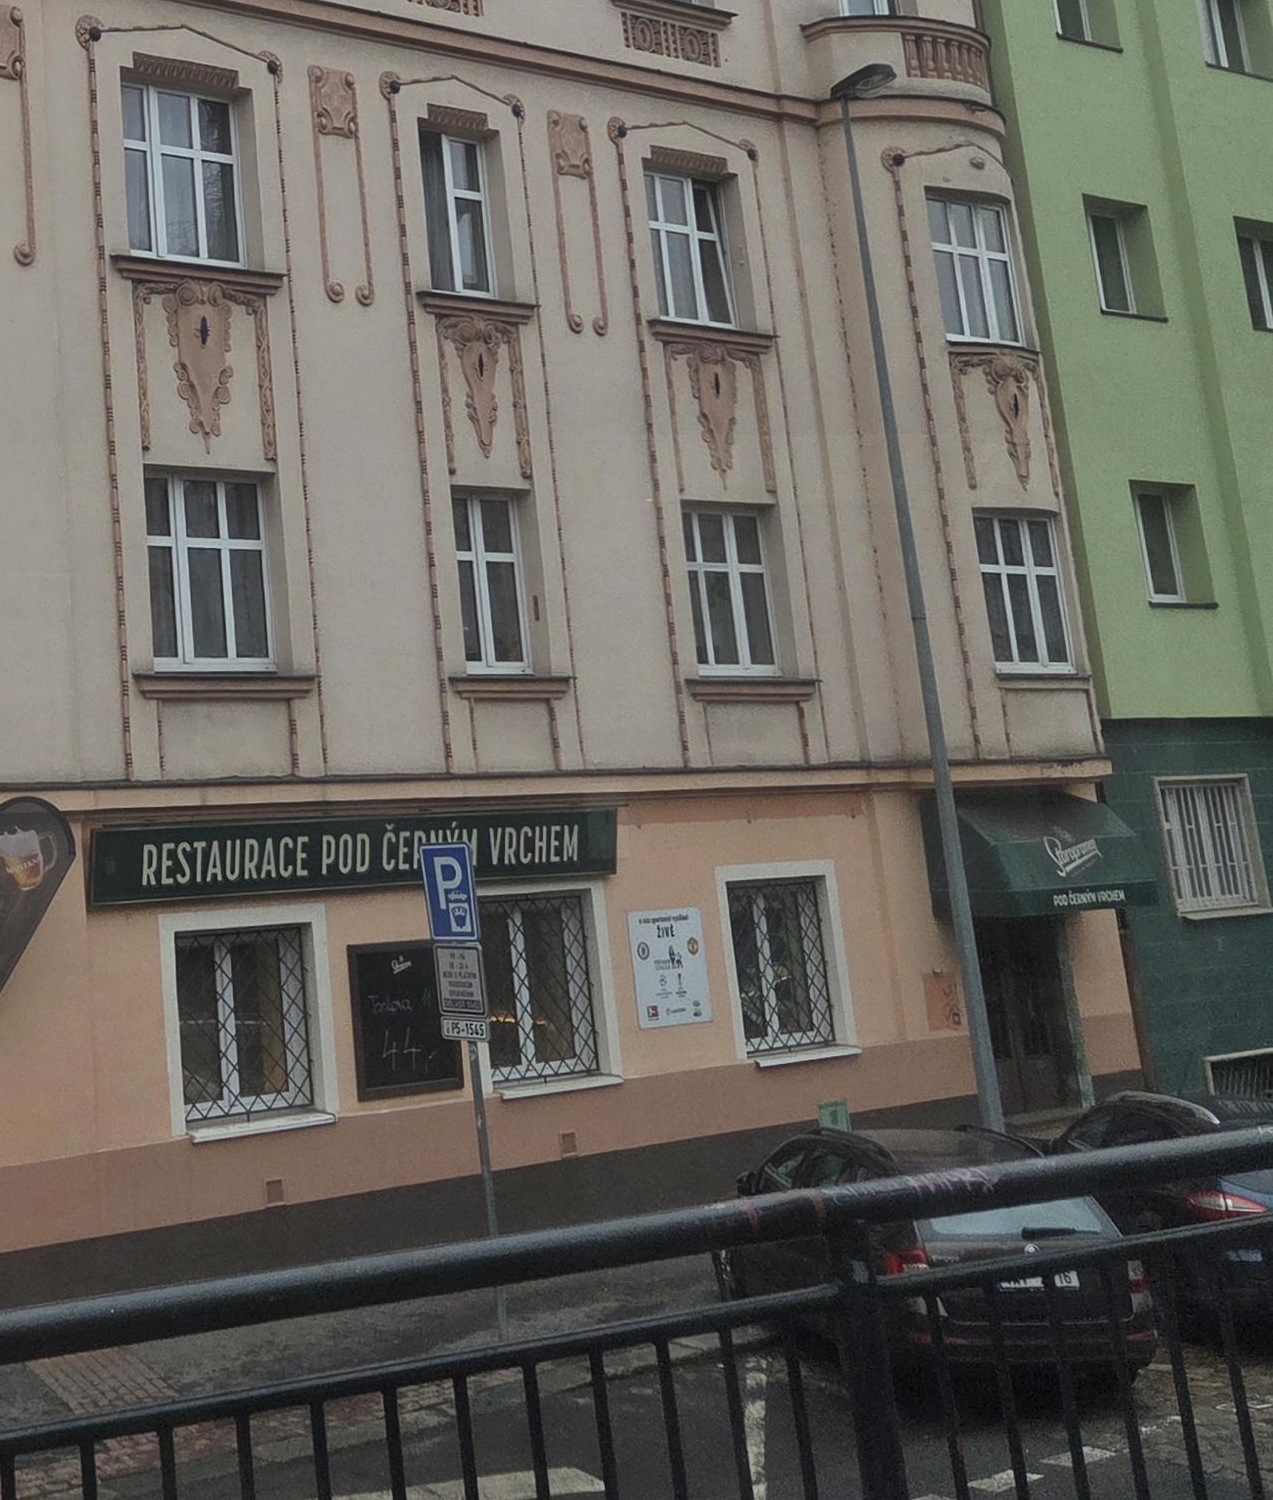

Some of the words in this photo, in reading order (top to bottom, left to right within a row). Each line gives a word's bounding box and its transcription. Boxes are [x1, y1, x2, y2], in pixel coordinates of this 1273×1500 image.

[142, 836, 309, 886] RESTAURACE
[322, 833, 370, 875] POD
[489, 825, 578, 865] VRCHEM
[433, 857, 462, 910] P
[657, 923, 675, 938] ŽIVĚ
